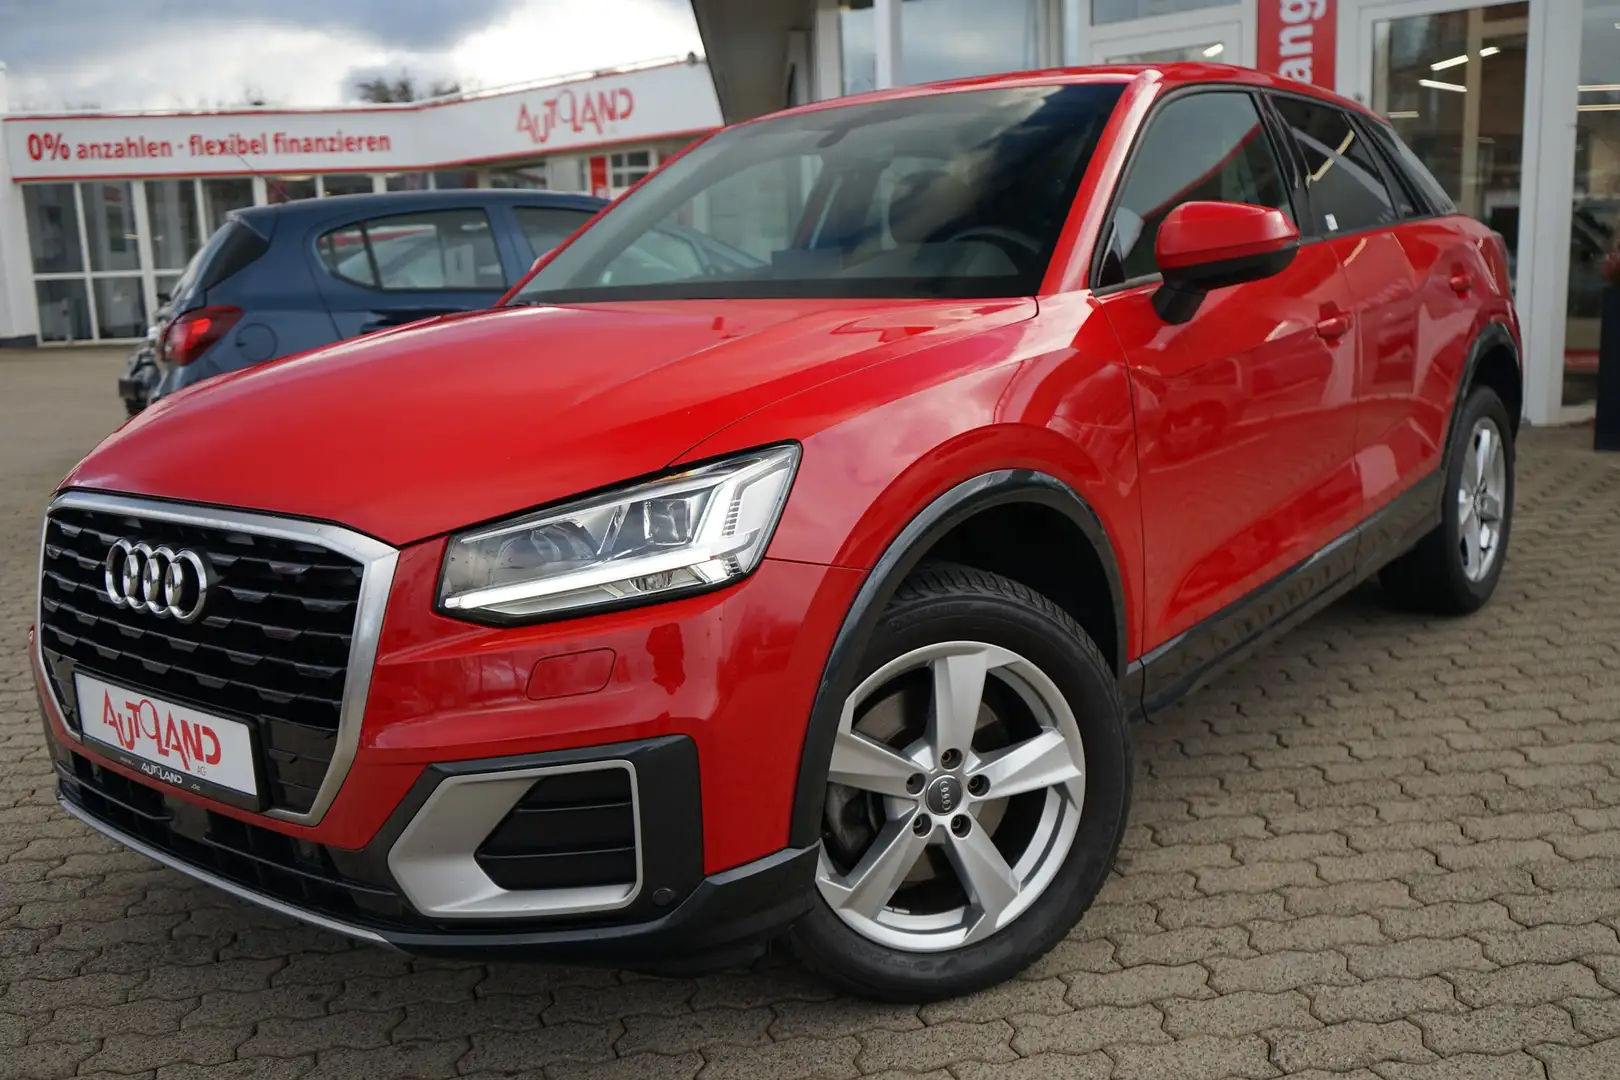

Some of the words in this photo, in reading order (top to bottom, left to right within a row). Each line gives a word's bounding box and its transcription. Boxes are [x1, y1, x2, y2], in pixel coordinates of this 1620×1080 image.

[516, 88, 635, 144] AUTOLAND
[27, 132, 71, 161] 0%
[76, 136, 173, 160] anzahlen
[188, 132, 268, 156] flexibel
[272, 128, 391, 153] finanzieren
[103, 688, 222, 771] AUTOLAND
[196, 765, 207, 777] AG
